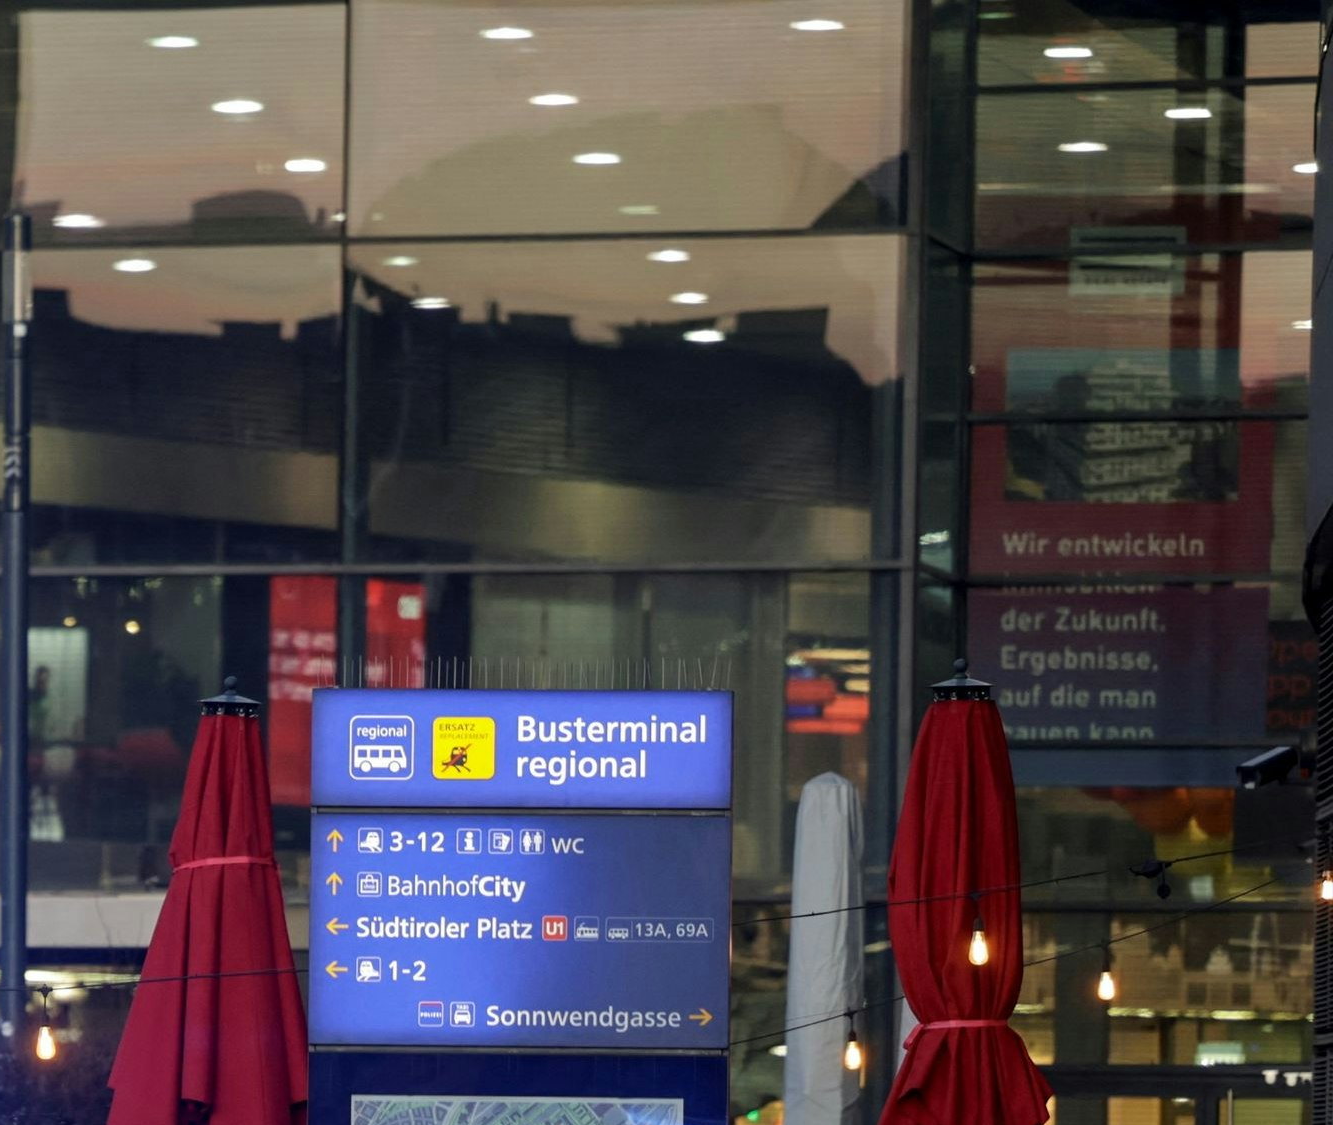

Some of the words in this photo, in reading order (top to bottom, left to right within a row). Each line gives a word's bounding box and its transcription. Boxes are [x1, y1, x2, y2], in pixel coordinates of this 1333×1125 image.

[1002, 532, 1049, 555] Wir
[1058, 532, 1205, 557] entwickeln
[1000, 608, 1044, 632] der
[1000, 685, 1041, 708] auf
[1050, 685, 1089, 708] die
[1100, 690, 1156, 708] man
[357, 723, 407, 740] regional
[438, 722, 476, 732] ERSATZ
[516, 714, 707, 744] Busterminal
[516, 749, 647, 786] regional
[389, 831, 445, 852] 3-12
[551, 837, 585, 855] WC
[387, 874, 526, 902] BahnhofCity
[356, 915, 470, 940] Südtiroler
[477, 916, 533, 940] Platz
[545, 921, 564, 936] U1
[635, 922, 671, 940] 13A,
[676, 922, 709, 938] 69A
[388, 960, 426, 982] 1-2
[485, 1004, 681, 1033] Sonnwendgasse
